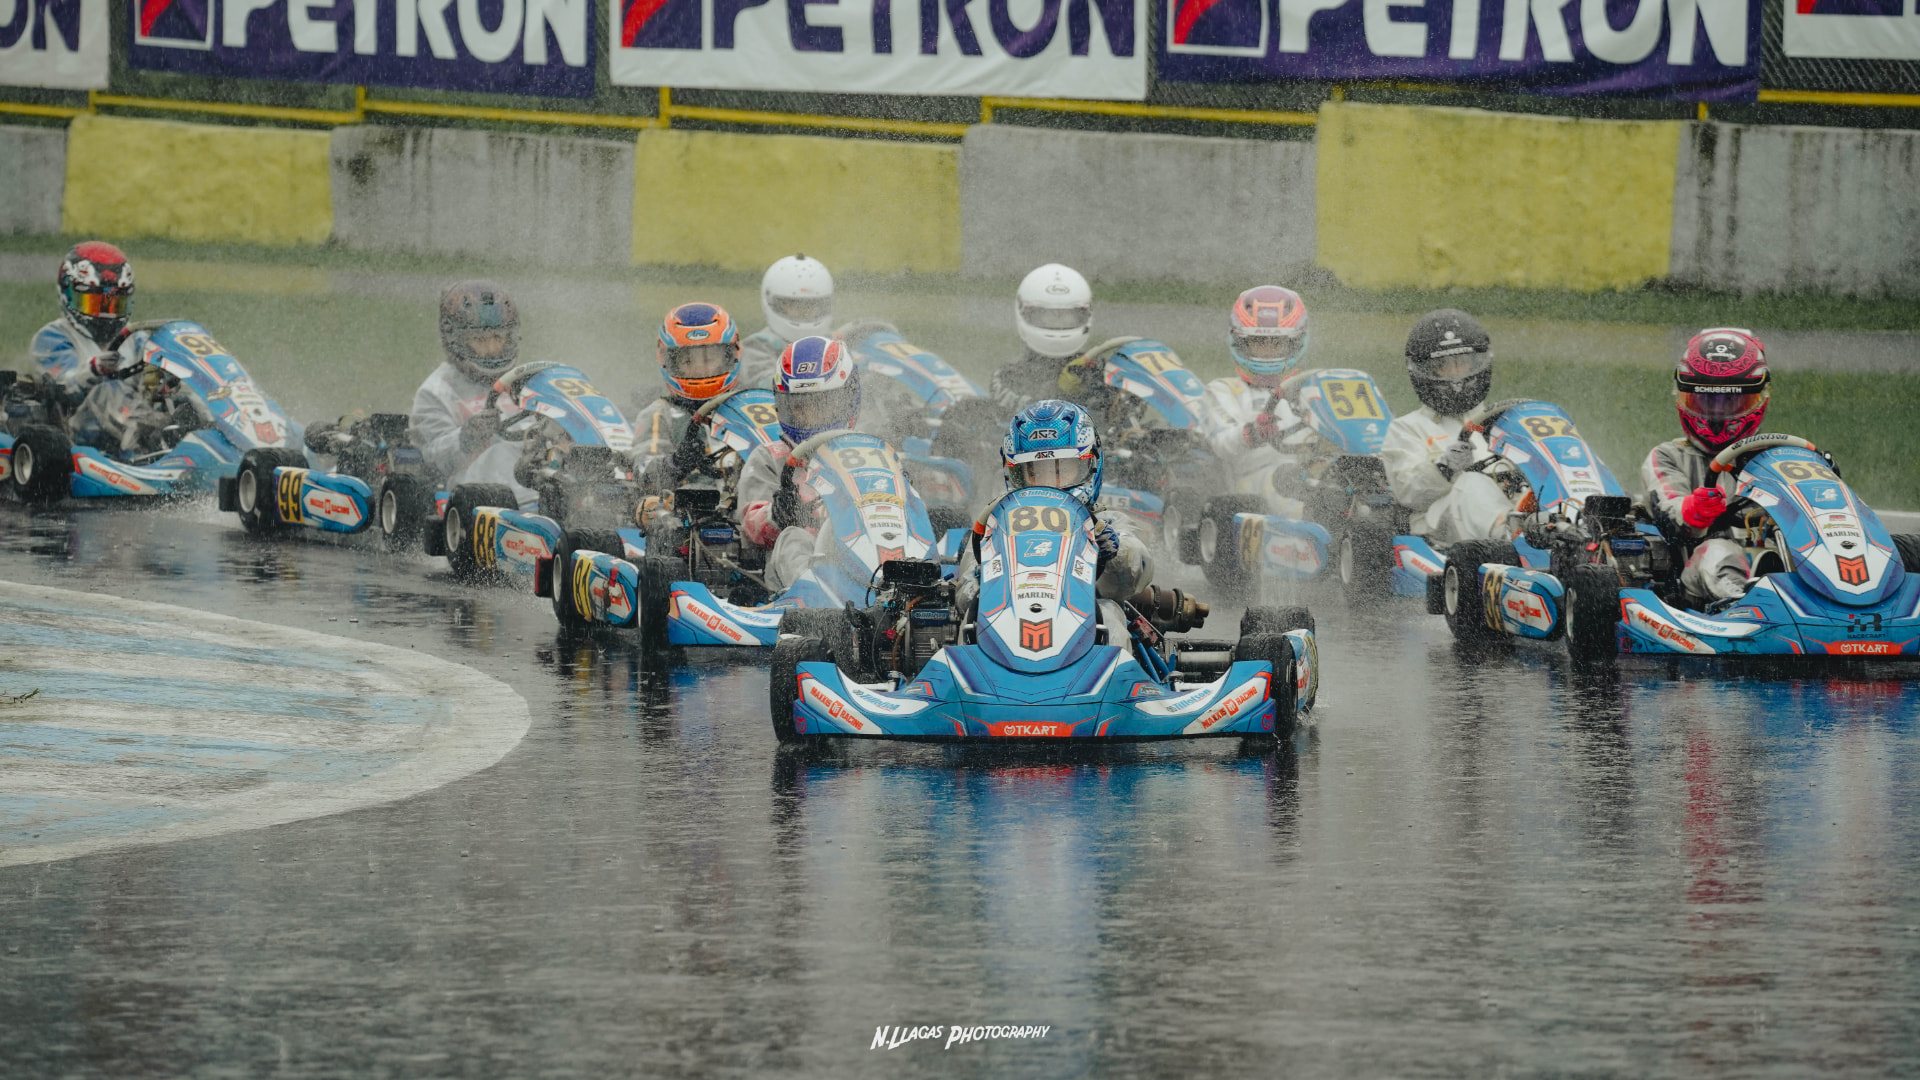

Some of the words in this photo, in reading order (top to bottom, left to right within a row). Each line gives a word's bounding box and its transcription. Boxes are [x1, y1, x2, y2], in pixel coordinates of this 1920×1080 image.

[1327, 382, 1378, 417] 51
[838, 448, 891, 470] 81
[1012, 506, 1068, 533] 80
[1017, 591, 1056, 601] MARLINE
[686, 602, 709, 622] MAXXIS
[718, 623, 743, 642] RACING
[810, 686, 833, 708] MAXXIS
[839, 709, 864, 731] RACING
[1173, 688, 1213, 711] Tillotson
[1201, 707, 1228, 730] MAXXIS
[1235, 686, 1258, 706] RACING
